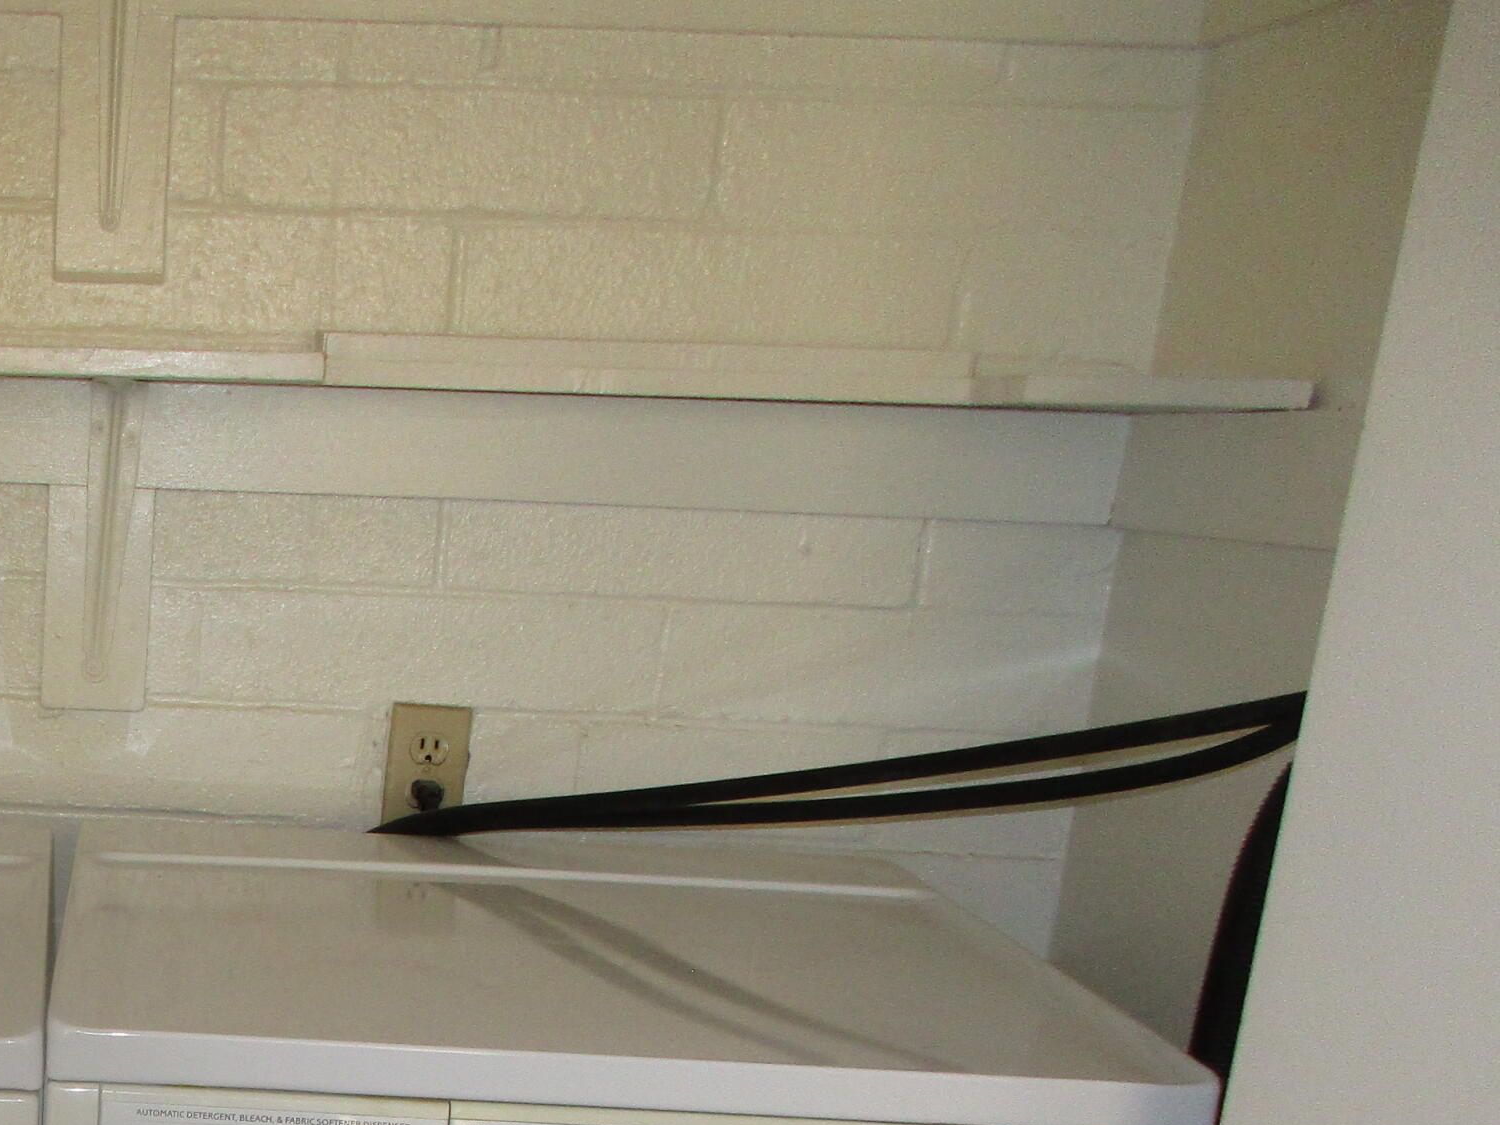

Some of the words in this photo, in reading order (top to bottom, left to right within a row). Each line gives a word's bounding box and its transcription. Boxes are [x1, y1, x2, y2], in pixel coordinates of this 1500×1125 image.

[136, 1108, 185, 1119] AUTOMATIC
[186, 1111, 238, 1122] DETERGENT,
[277, 1116, 284, 1125] &
[285, 1116, 315, 1125] FABRIC
